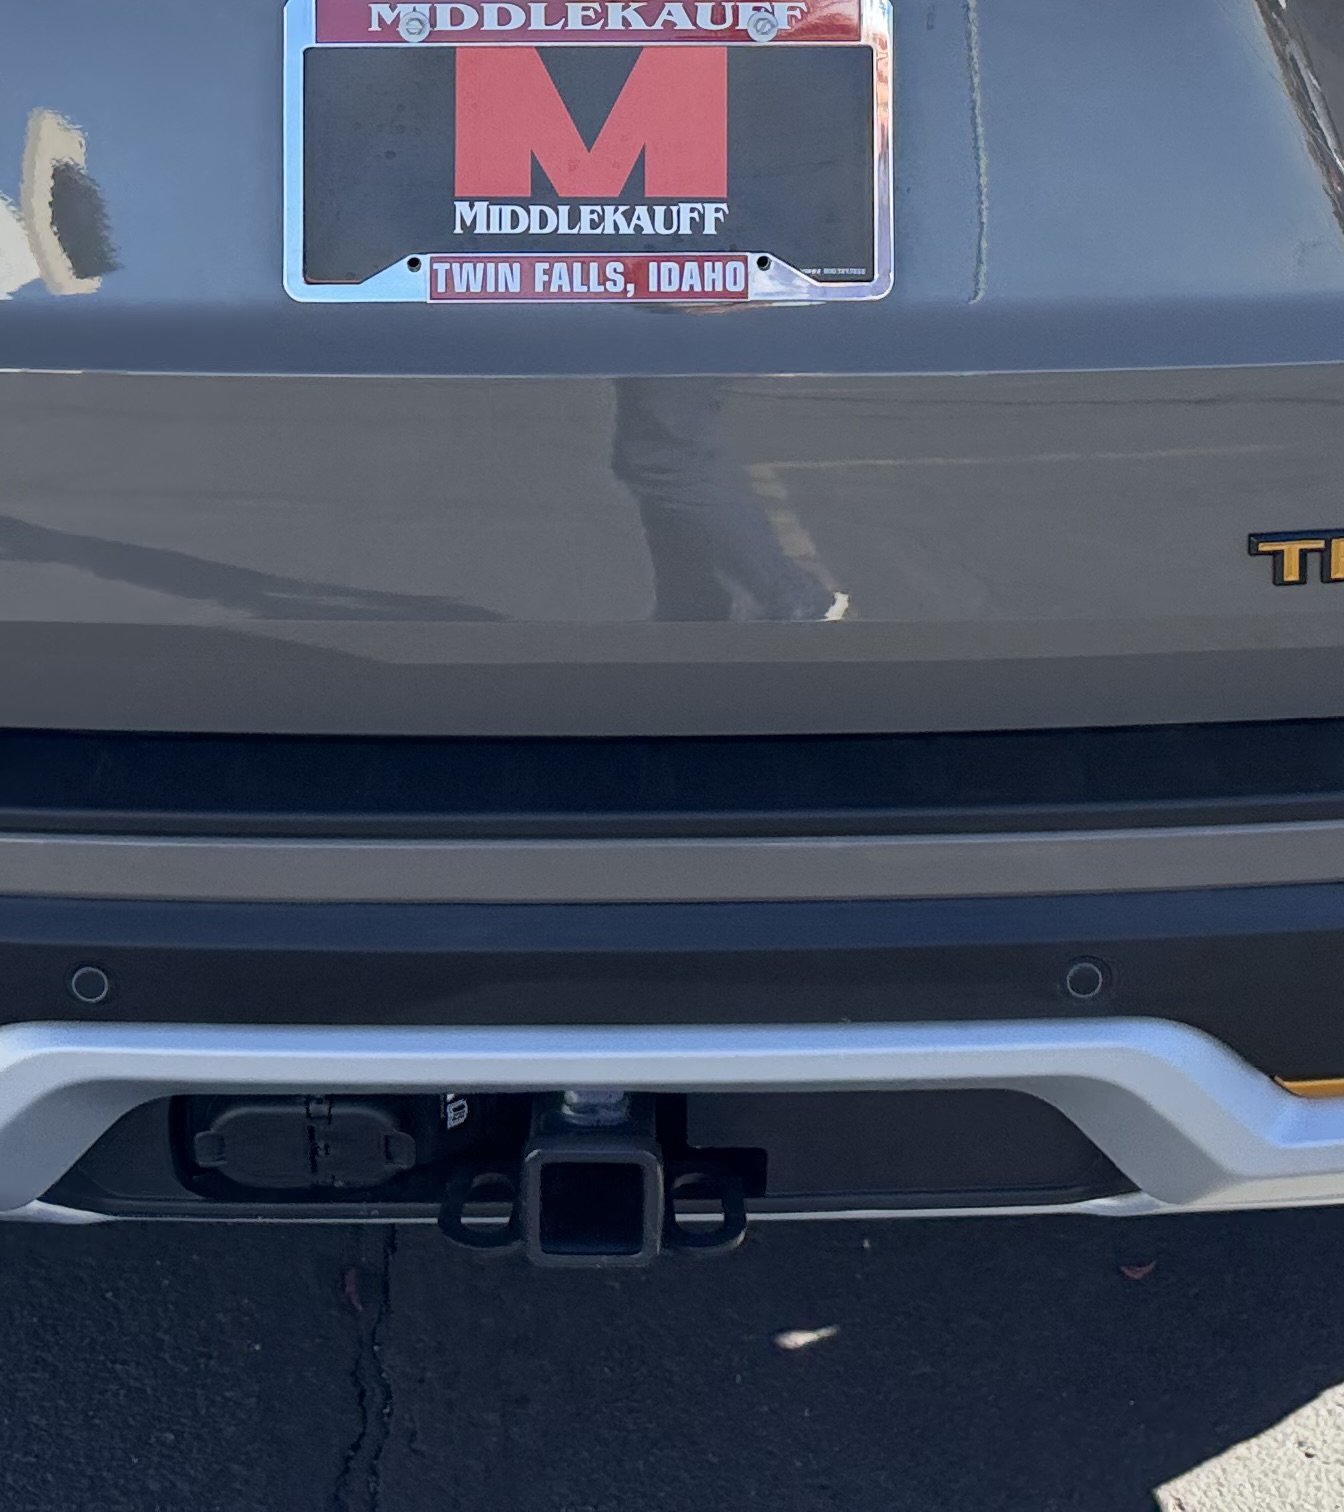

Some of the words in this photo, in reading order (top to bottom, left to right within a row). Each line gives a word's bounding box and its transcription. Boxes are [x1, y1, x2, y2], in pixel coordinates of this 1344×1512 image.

[454, 46, 728, 197] M
[453, 201, 729, 235] MIDDLEKAUFF
[433, 261, 521, 293] TWIN
[534, 261, 635, 298] FALLS,
[649, 261, 746, 293] IDAHO
